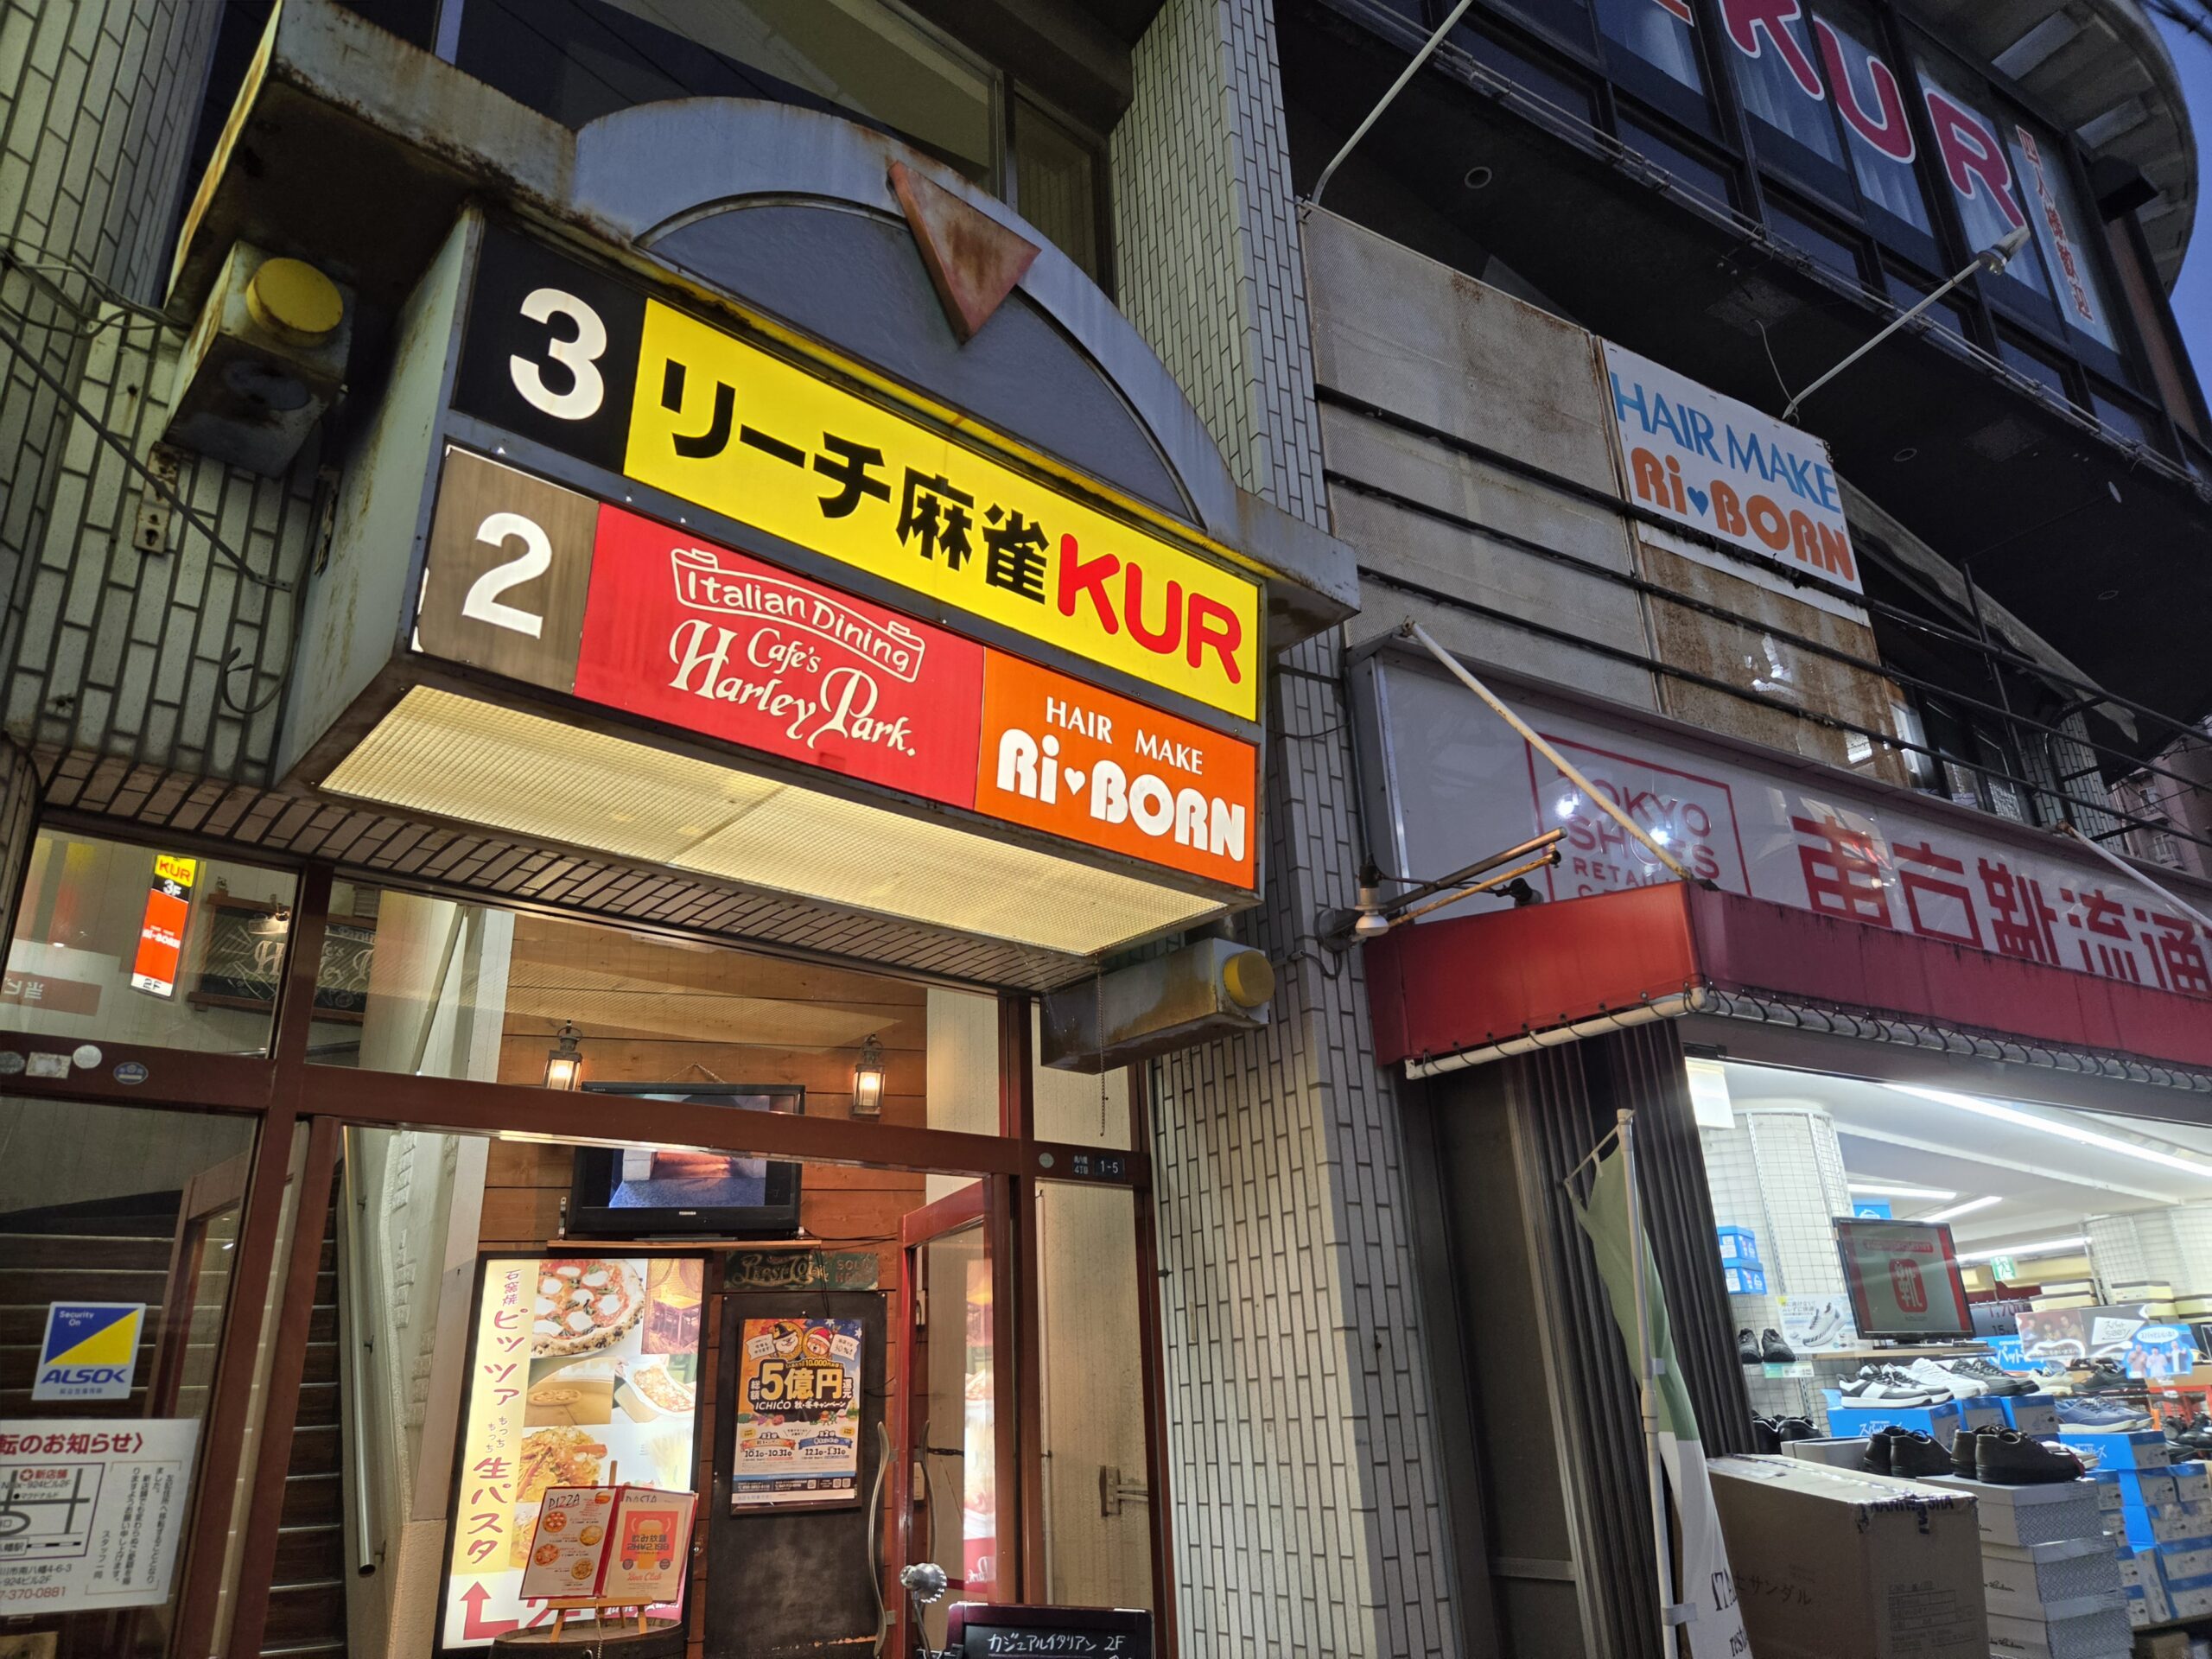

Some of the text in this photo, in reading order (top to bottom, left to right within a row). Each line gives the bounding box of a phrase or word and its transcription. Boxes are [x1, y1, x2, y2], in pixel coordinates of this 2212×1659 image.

[1719, 0, 2027, 230] KUR
[509, 288, 607, 420] 3
[1609, 372, 1841, 515] HAIR MAKE
[661, 358, 1242, 685] リーチ麻雀 KUR
[461, 512, 554, 640] 2
[687, 570, 912, 673] Italian Dining
[668, 619, 817, 741] Harley
[1046, 696, 1204, 776] HAIR MAKE
[159, 861, 191, 881] KUR
[162, 879, 182, 896] 3F
[1791, 815, 2212, 995] 東京靴流通
[143, 977, 162, 990] 2F
[1101, 1160, 1119, 1173] 1-5
[502, 1268, 522, 1306] 石窯焼
[59, 1311, 94, 1319] Security
[41, 1369, 127, 1384] ALSOK
[761, 1363, 843, 1400] 5億円
[755, 1400, 791, 1410] ICHICO
[467, 1458, 512, 1565] 生パスタ
[549, 1494, 580, 1510] PIZZA
[988, 1632, 1126, 1652] カジュアルイタリアン 2F
